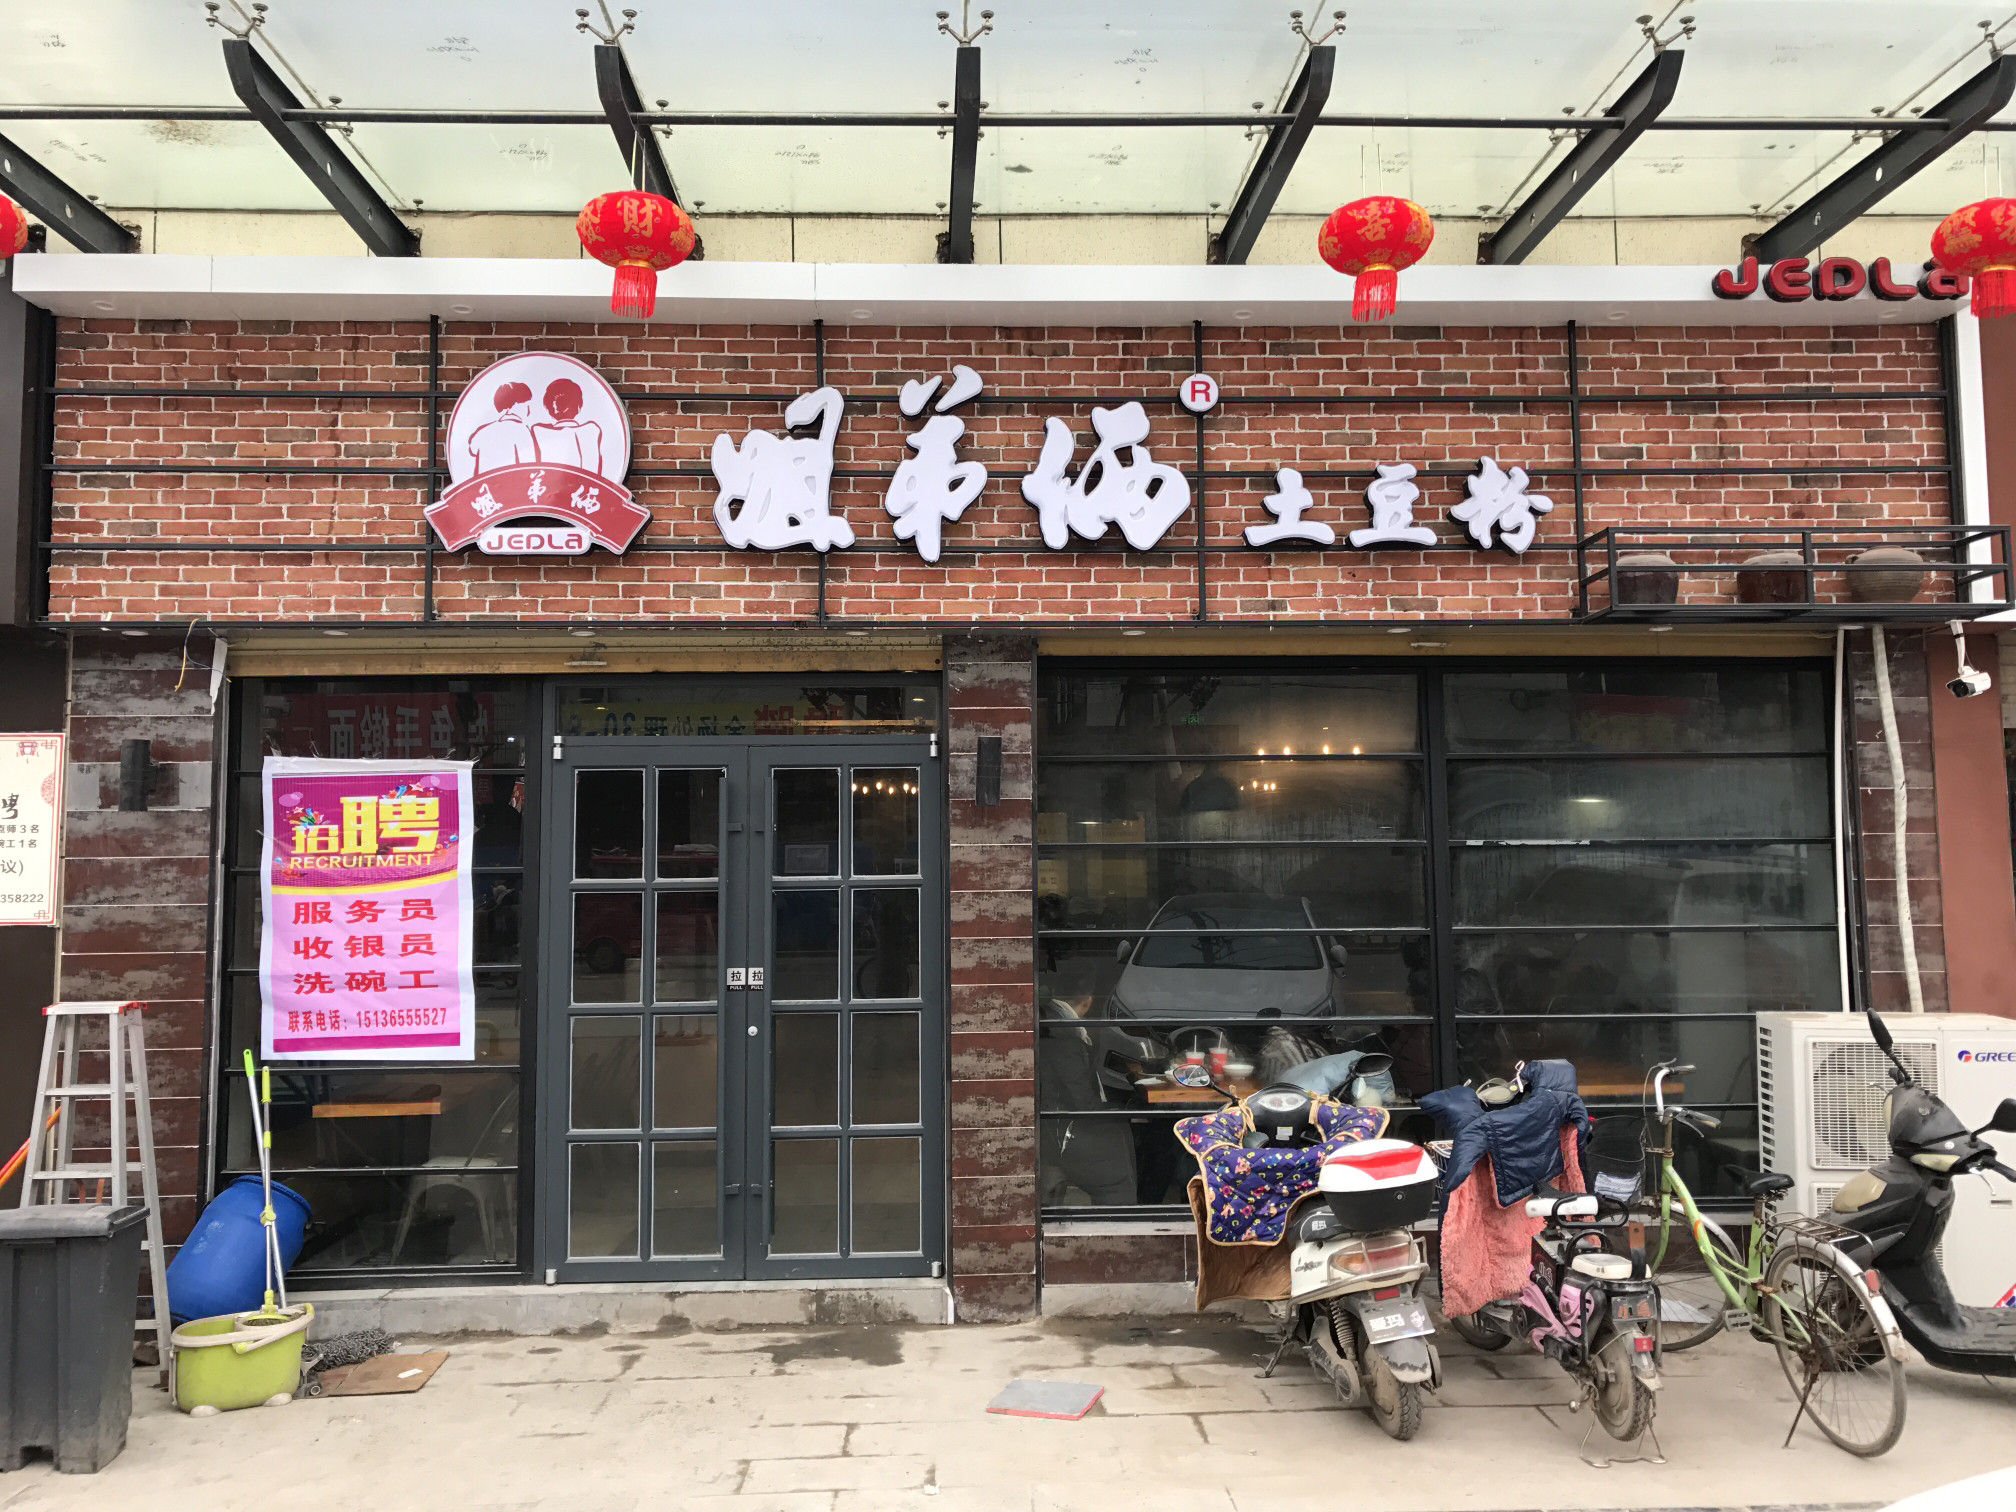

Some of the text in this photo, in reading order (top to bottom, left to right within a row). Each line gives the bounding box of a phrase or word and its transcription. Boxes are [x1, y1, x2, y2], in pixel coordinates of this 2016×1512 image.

[1244, 455, 1554, 556] 土豆粉
[291, 796, 440, 855] 招聘
[289, 853, 435, 869] RECRUITMENT
[291, 898, 438, 925] 服务员
[292, 933, 438, 960] 收银员
[293, 969, 439, 995] 洗碗工
[730, 970, 742, 982] 拉
[752, 970, 763, 982] 拉
[1975, 1052, 2016, 1063] GREE
